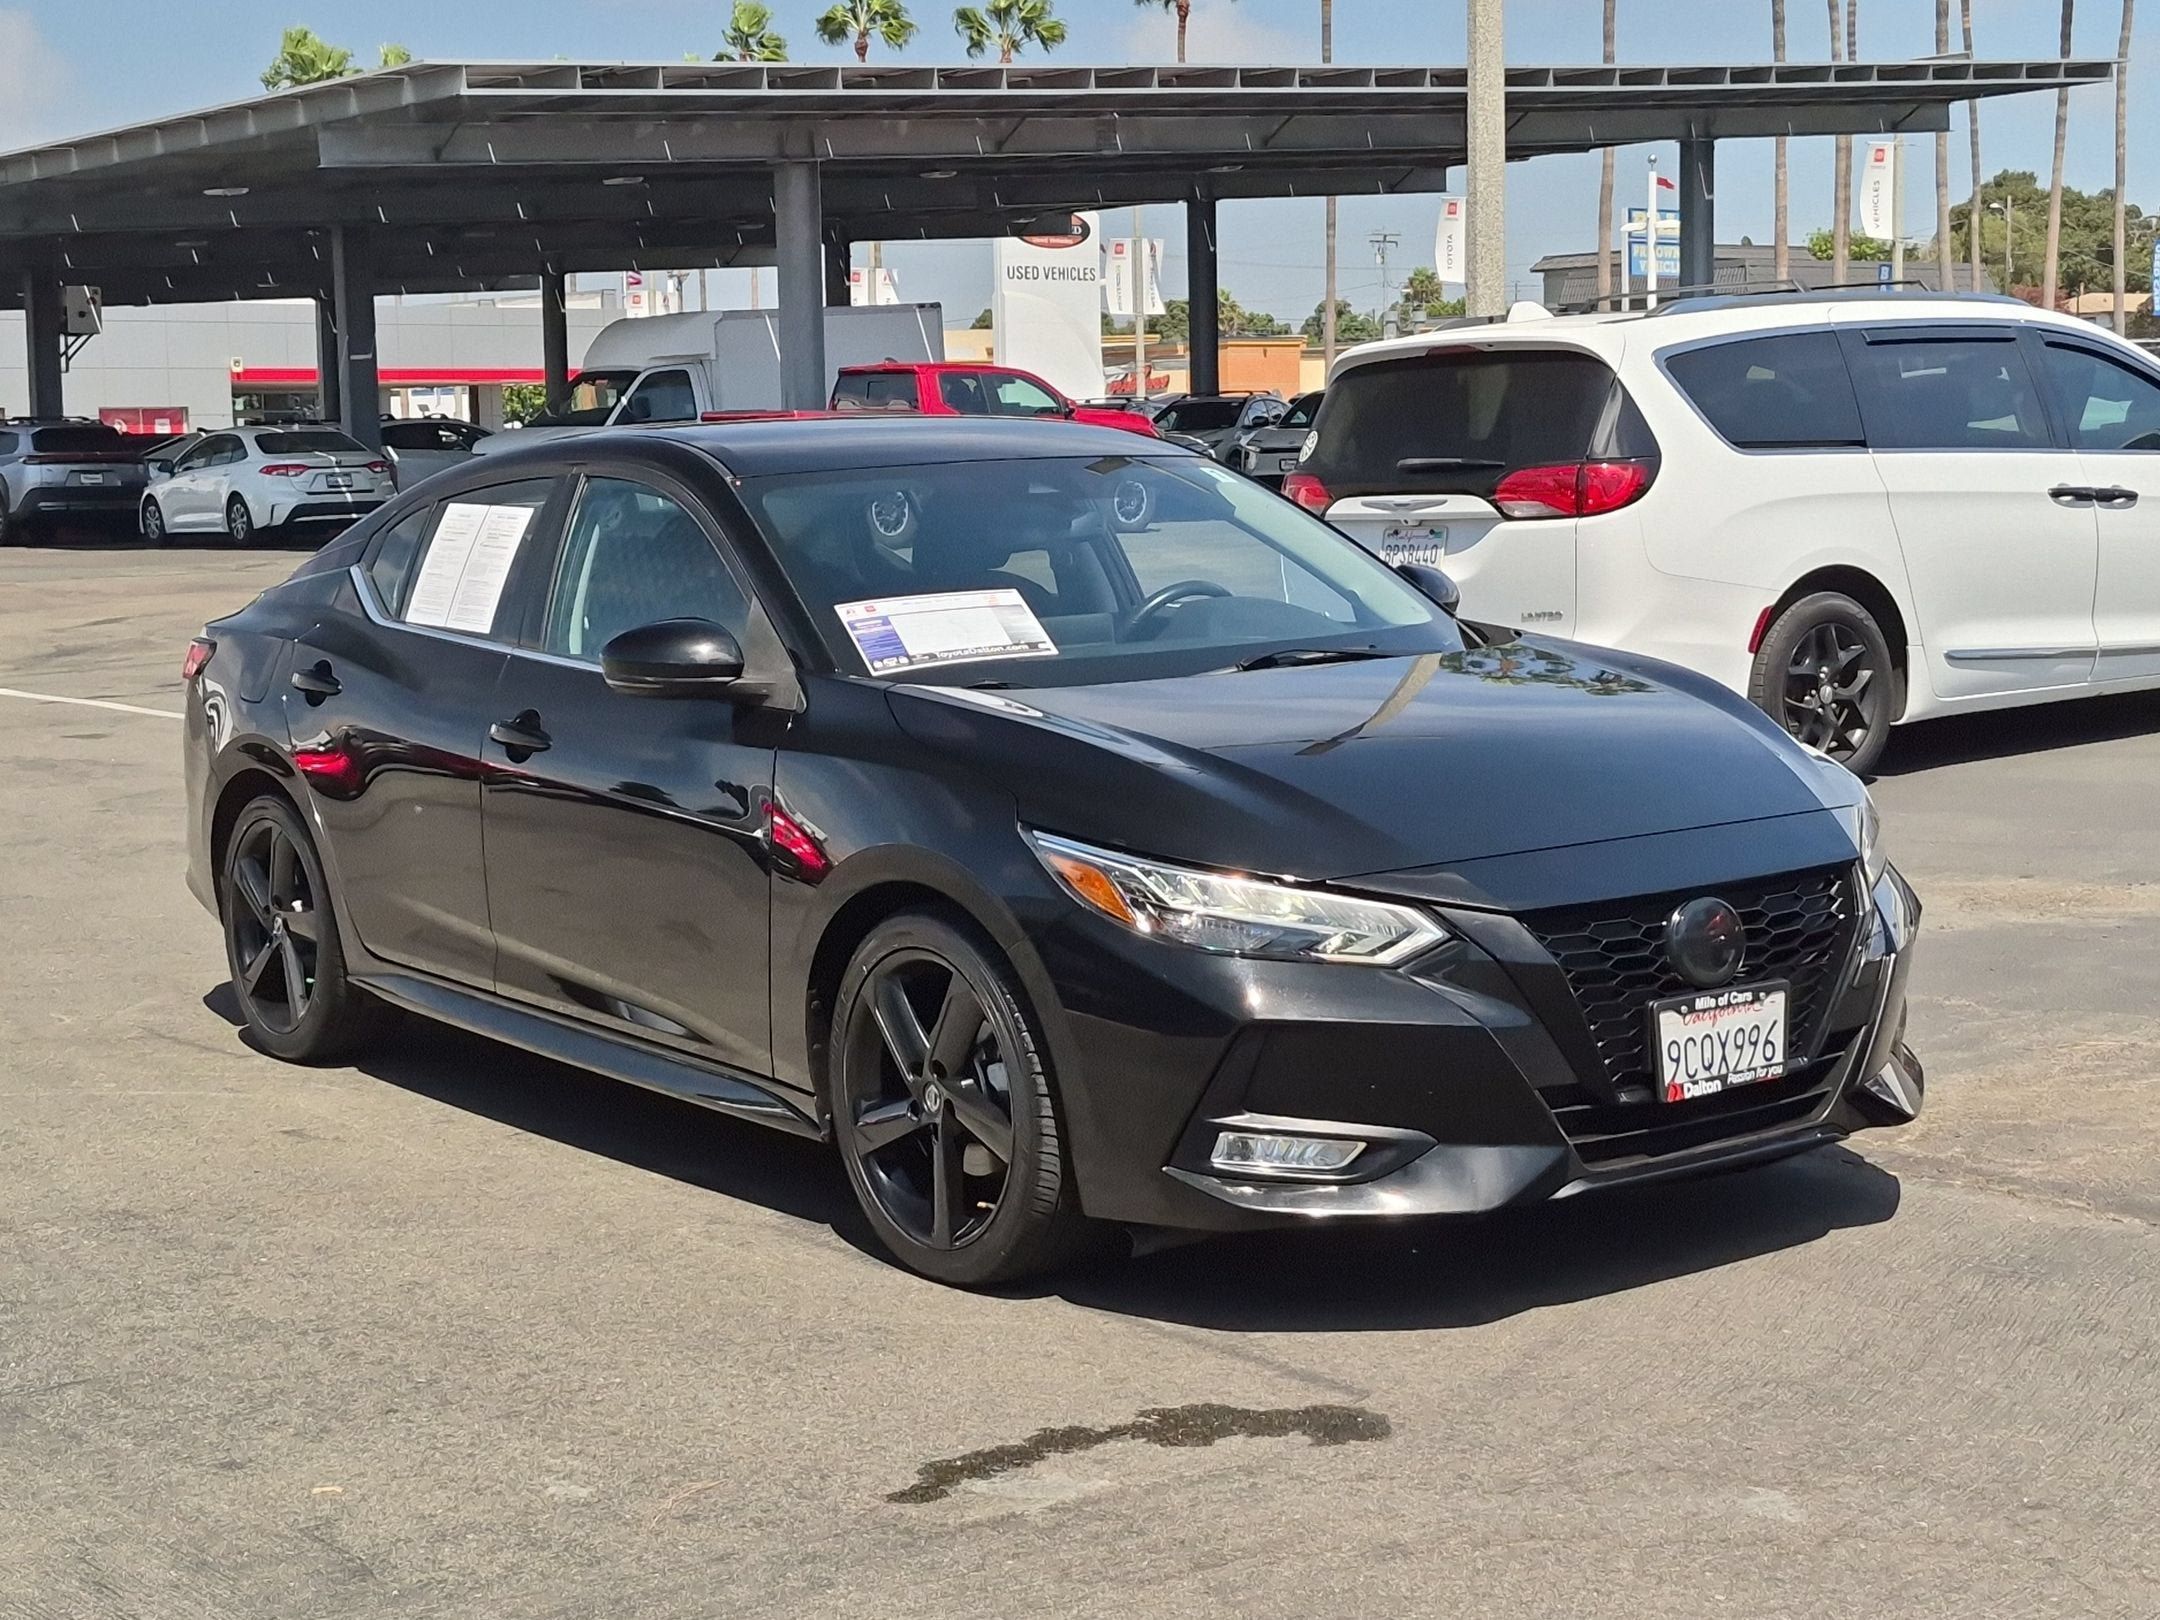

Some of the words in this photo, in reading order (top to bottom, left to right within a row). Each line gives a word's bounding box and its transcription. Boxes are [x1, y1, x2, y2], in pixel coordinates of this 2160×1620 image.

[1872, 180, 1880, 229] VEHICLES
[1007, 265, 1039, 281] USED
[1043, 266, 1096, 282] VEHICLES
[1385, 544, 1439, 565] 8PSB440
[1694, 996, 1716, 1010] Mile
[1717, 993, 1729, 1007] of
[1730, 991, 1753, 1004] Cars
[1667, 1020, 1778, 1084] 9CQX996
[1767, 1064, 1783, 1079] you
[1683, 1079, 1722, 1099] Dalton
